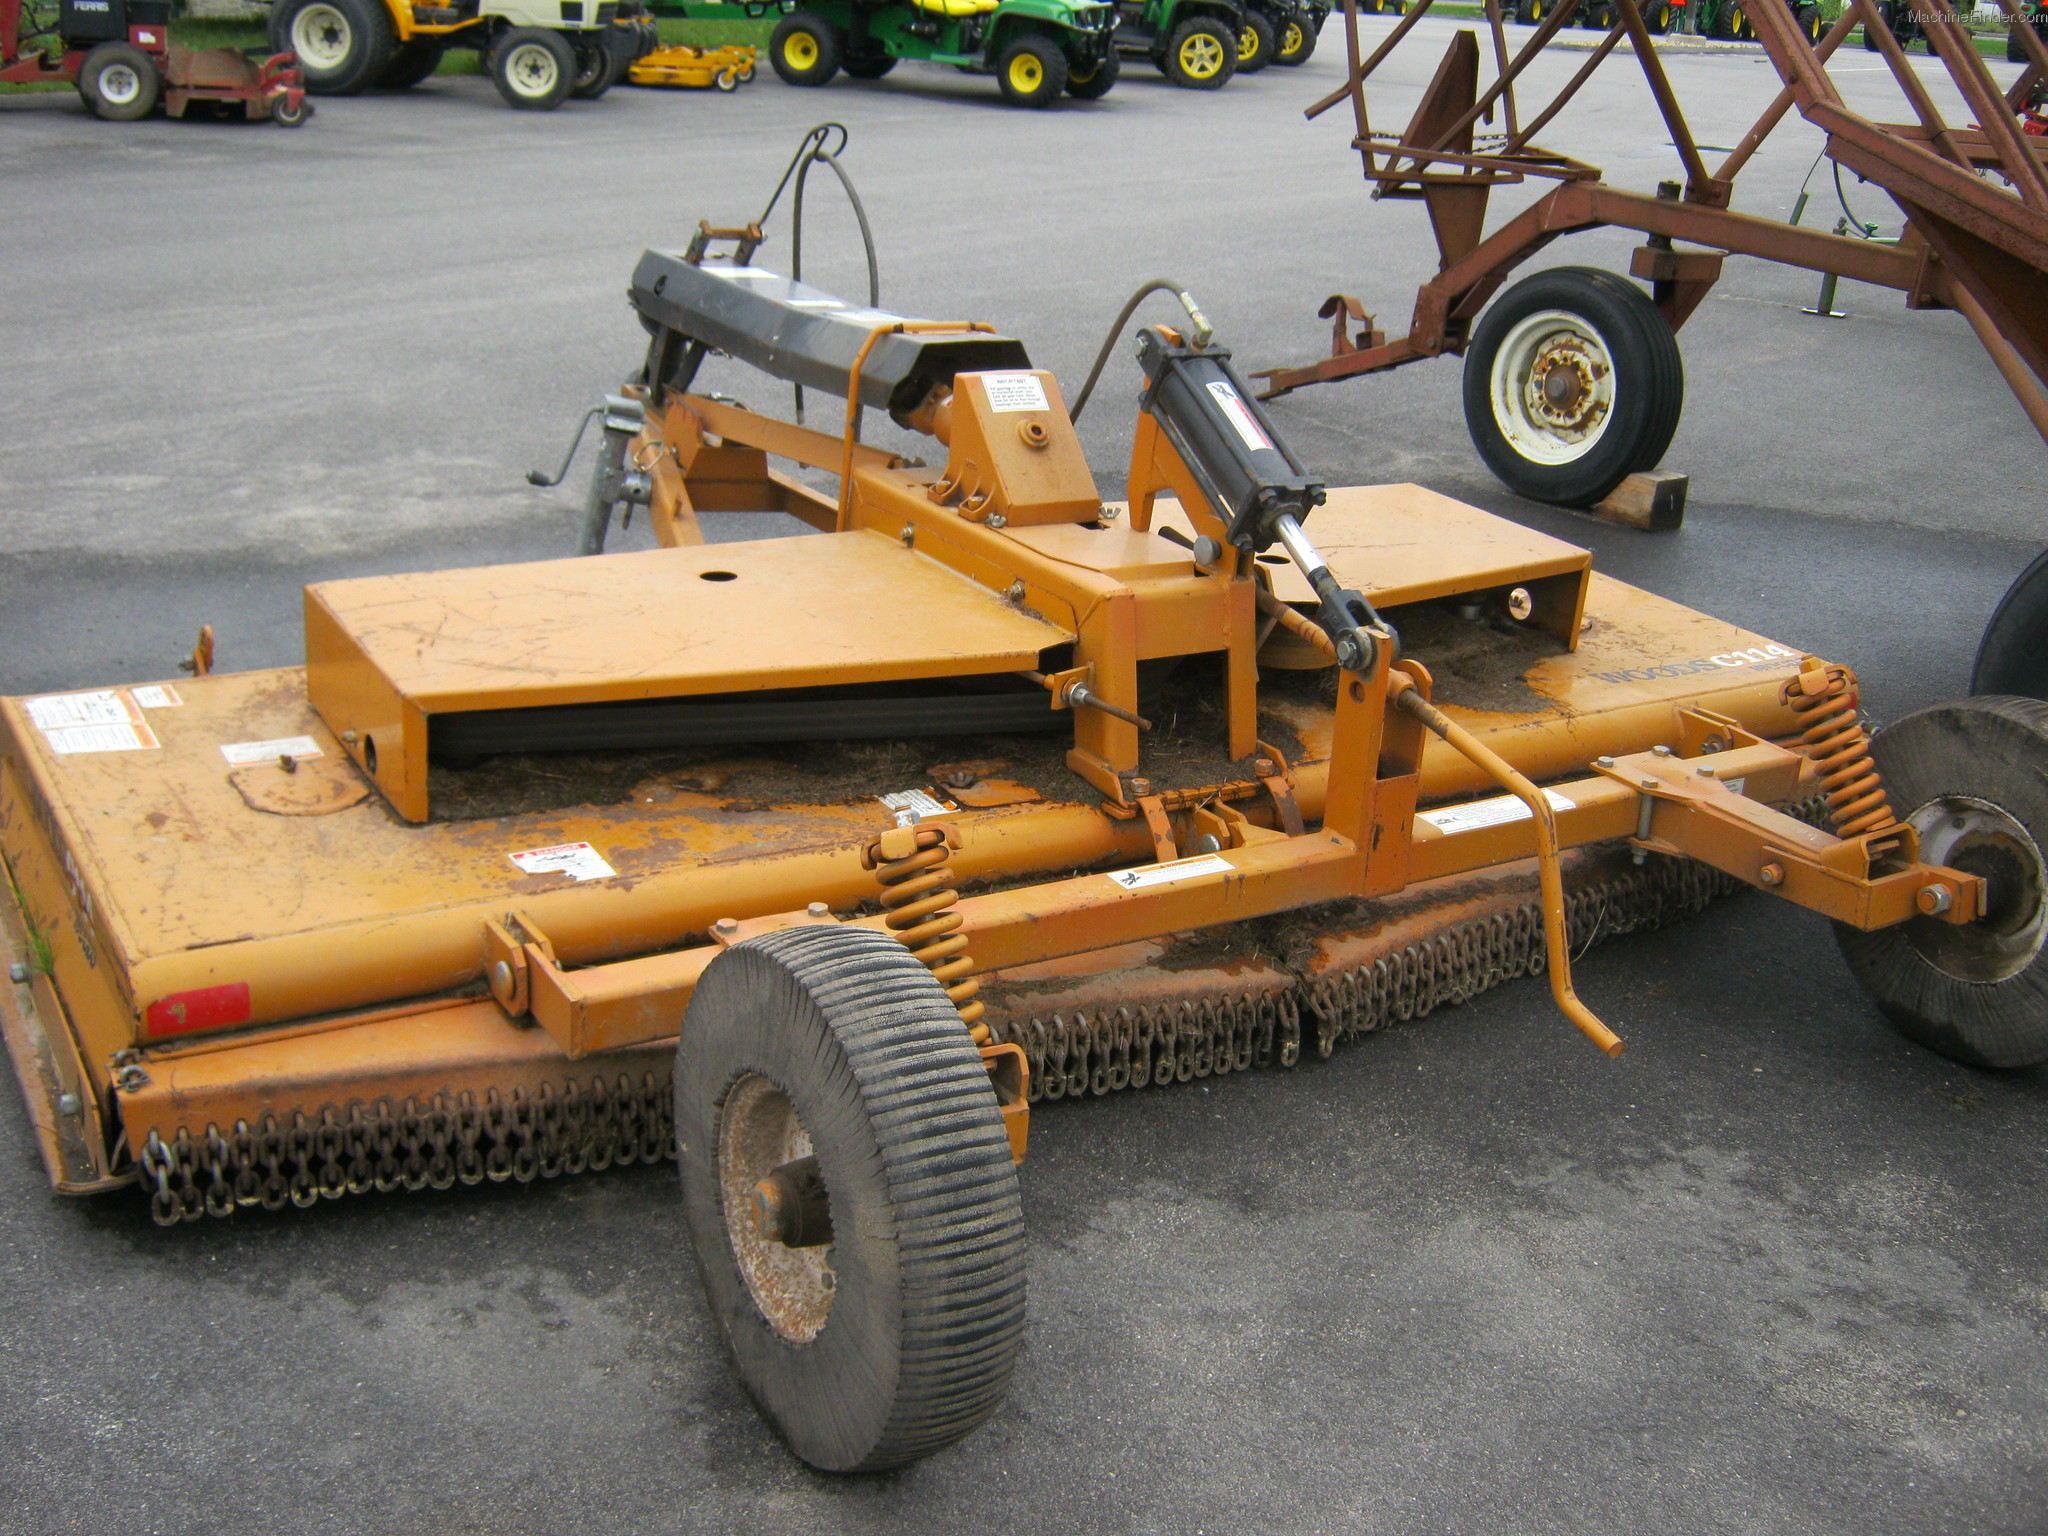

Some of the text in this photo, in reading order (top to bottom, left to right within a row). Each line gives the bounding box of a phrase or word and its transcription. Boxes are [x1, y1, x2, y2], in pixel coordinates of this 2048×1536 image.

[73, 0, 110, 12] FERRIS
[1588, 659, 1721, 684] WOODS
[1709, 644, 1795, 667] C114
